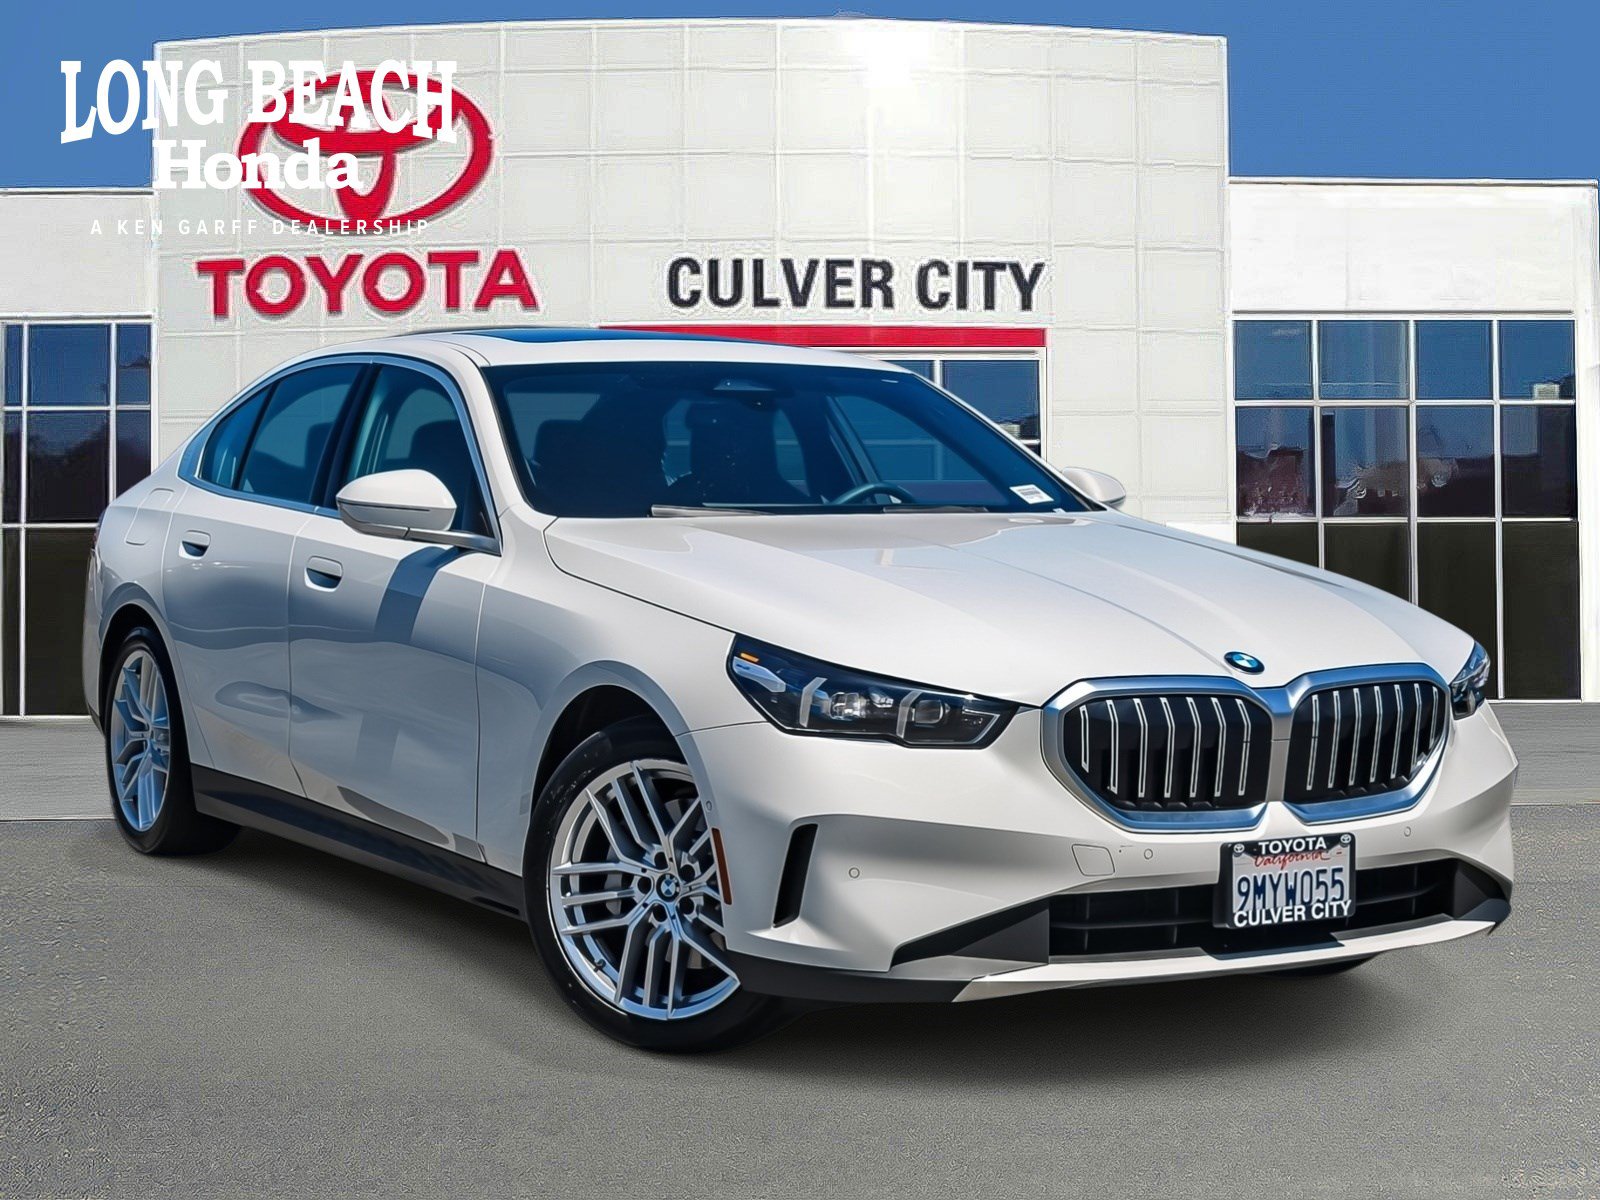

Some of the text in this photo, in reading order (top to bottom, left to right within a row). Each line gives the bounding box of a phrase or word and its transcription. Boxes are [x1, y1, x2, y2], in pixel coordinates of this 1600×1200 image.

[196, 250, 537, 319] TOYOTA
[668, 257, 1045, 311] CULVER CITY
[1258, 836, 1327, 854] TOYOTA
[1237, 867, 1345, 913] 9MYW055
[1233, 899, 1352, 928] CULVER CITY
